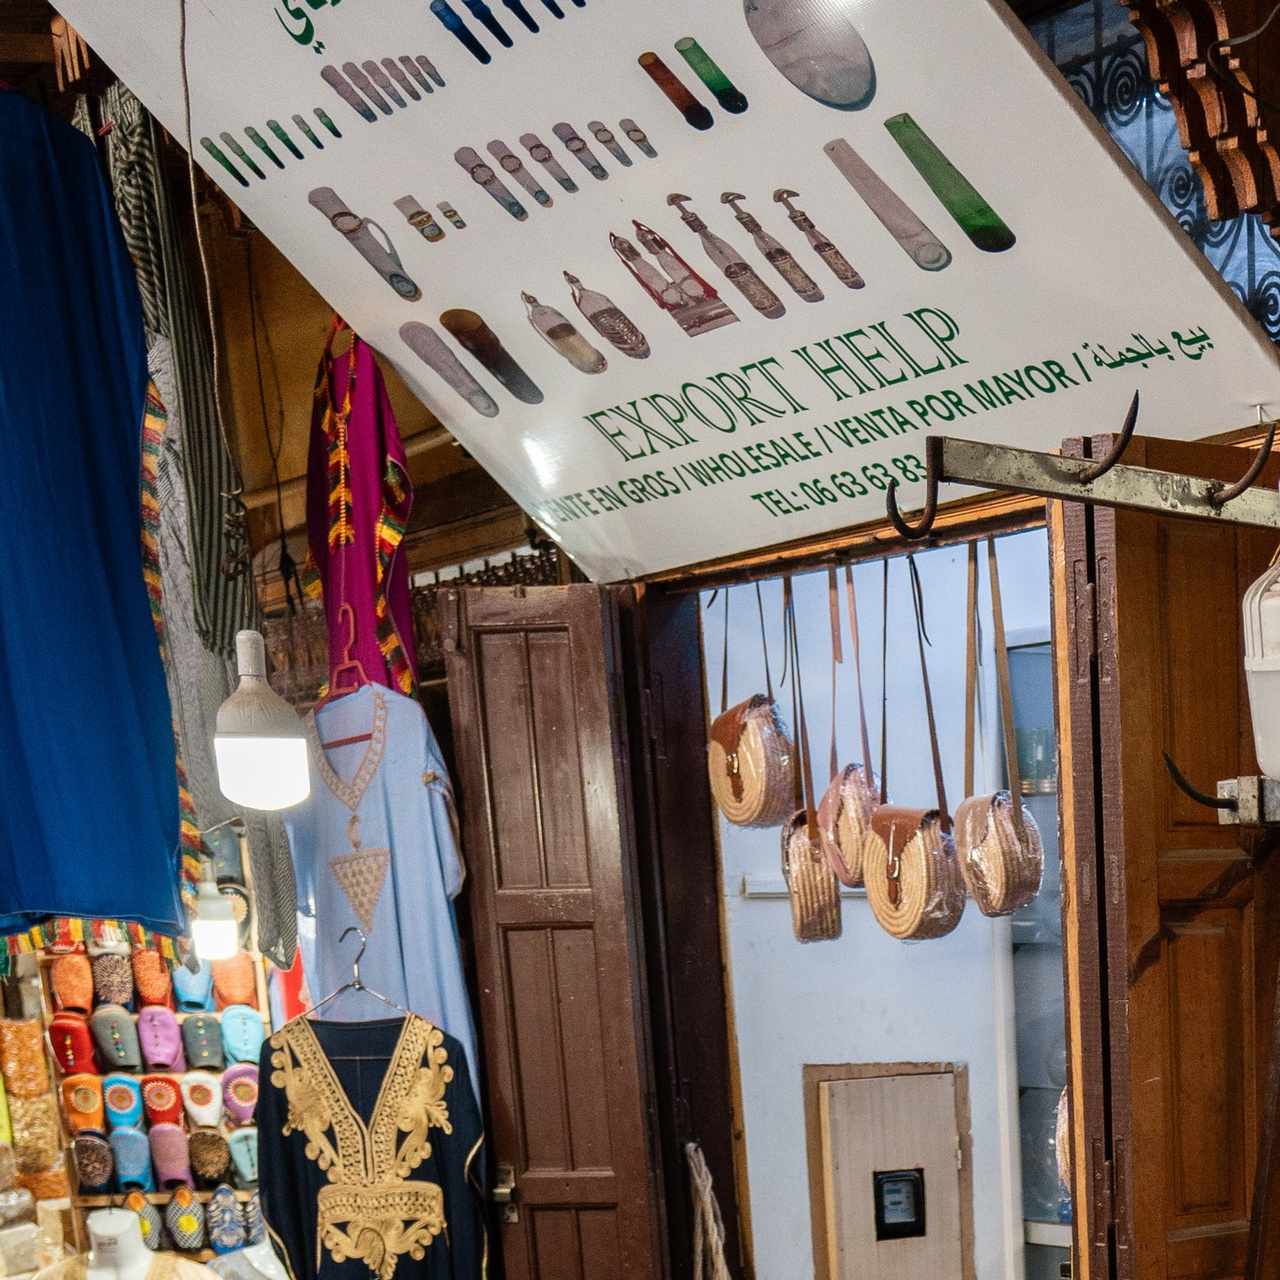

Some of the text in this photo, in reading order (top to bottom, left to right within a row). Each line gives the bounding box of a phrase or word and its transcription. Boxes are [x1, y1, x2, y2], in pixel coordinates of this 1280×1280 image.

[1081, 332, 1176, 370] بالجملة
[1170, 325, 1215, 361] بيع
[583, 306, 971, 464] EXPORT HELP
[963, 359, 1081, 412] MAYOR
[1071, 352, 1092, 383] /
[823, 405, 920, 449] VENTA
[905, 389, 977, 428] POR
[680, 431, 823, 487] WHOLESALE
[813, 426, 833, 454] /
[617, 470, 681, 505] GROS
[672, 466, 692, 492] /
[750, 454, 928, 518] TEL: 06 63 63 83
[588, 485, 629, 512] EN
